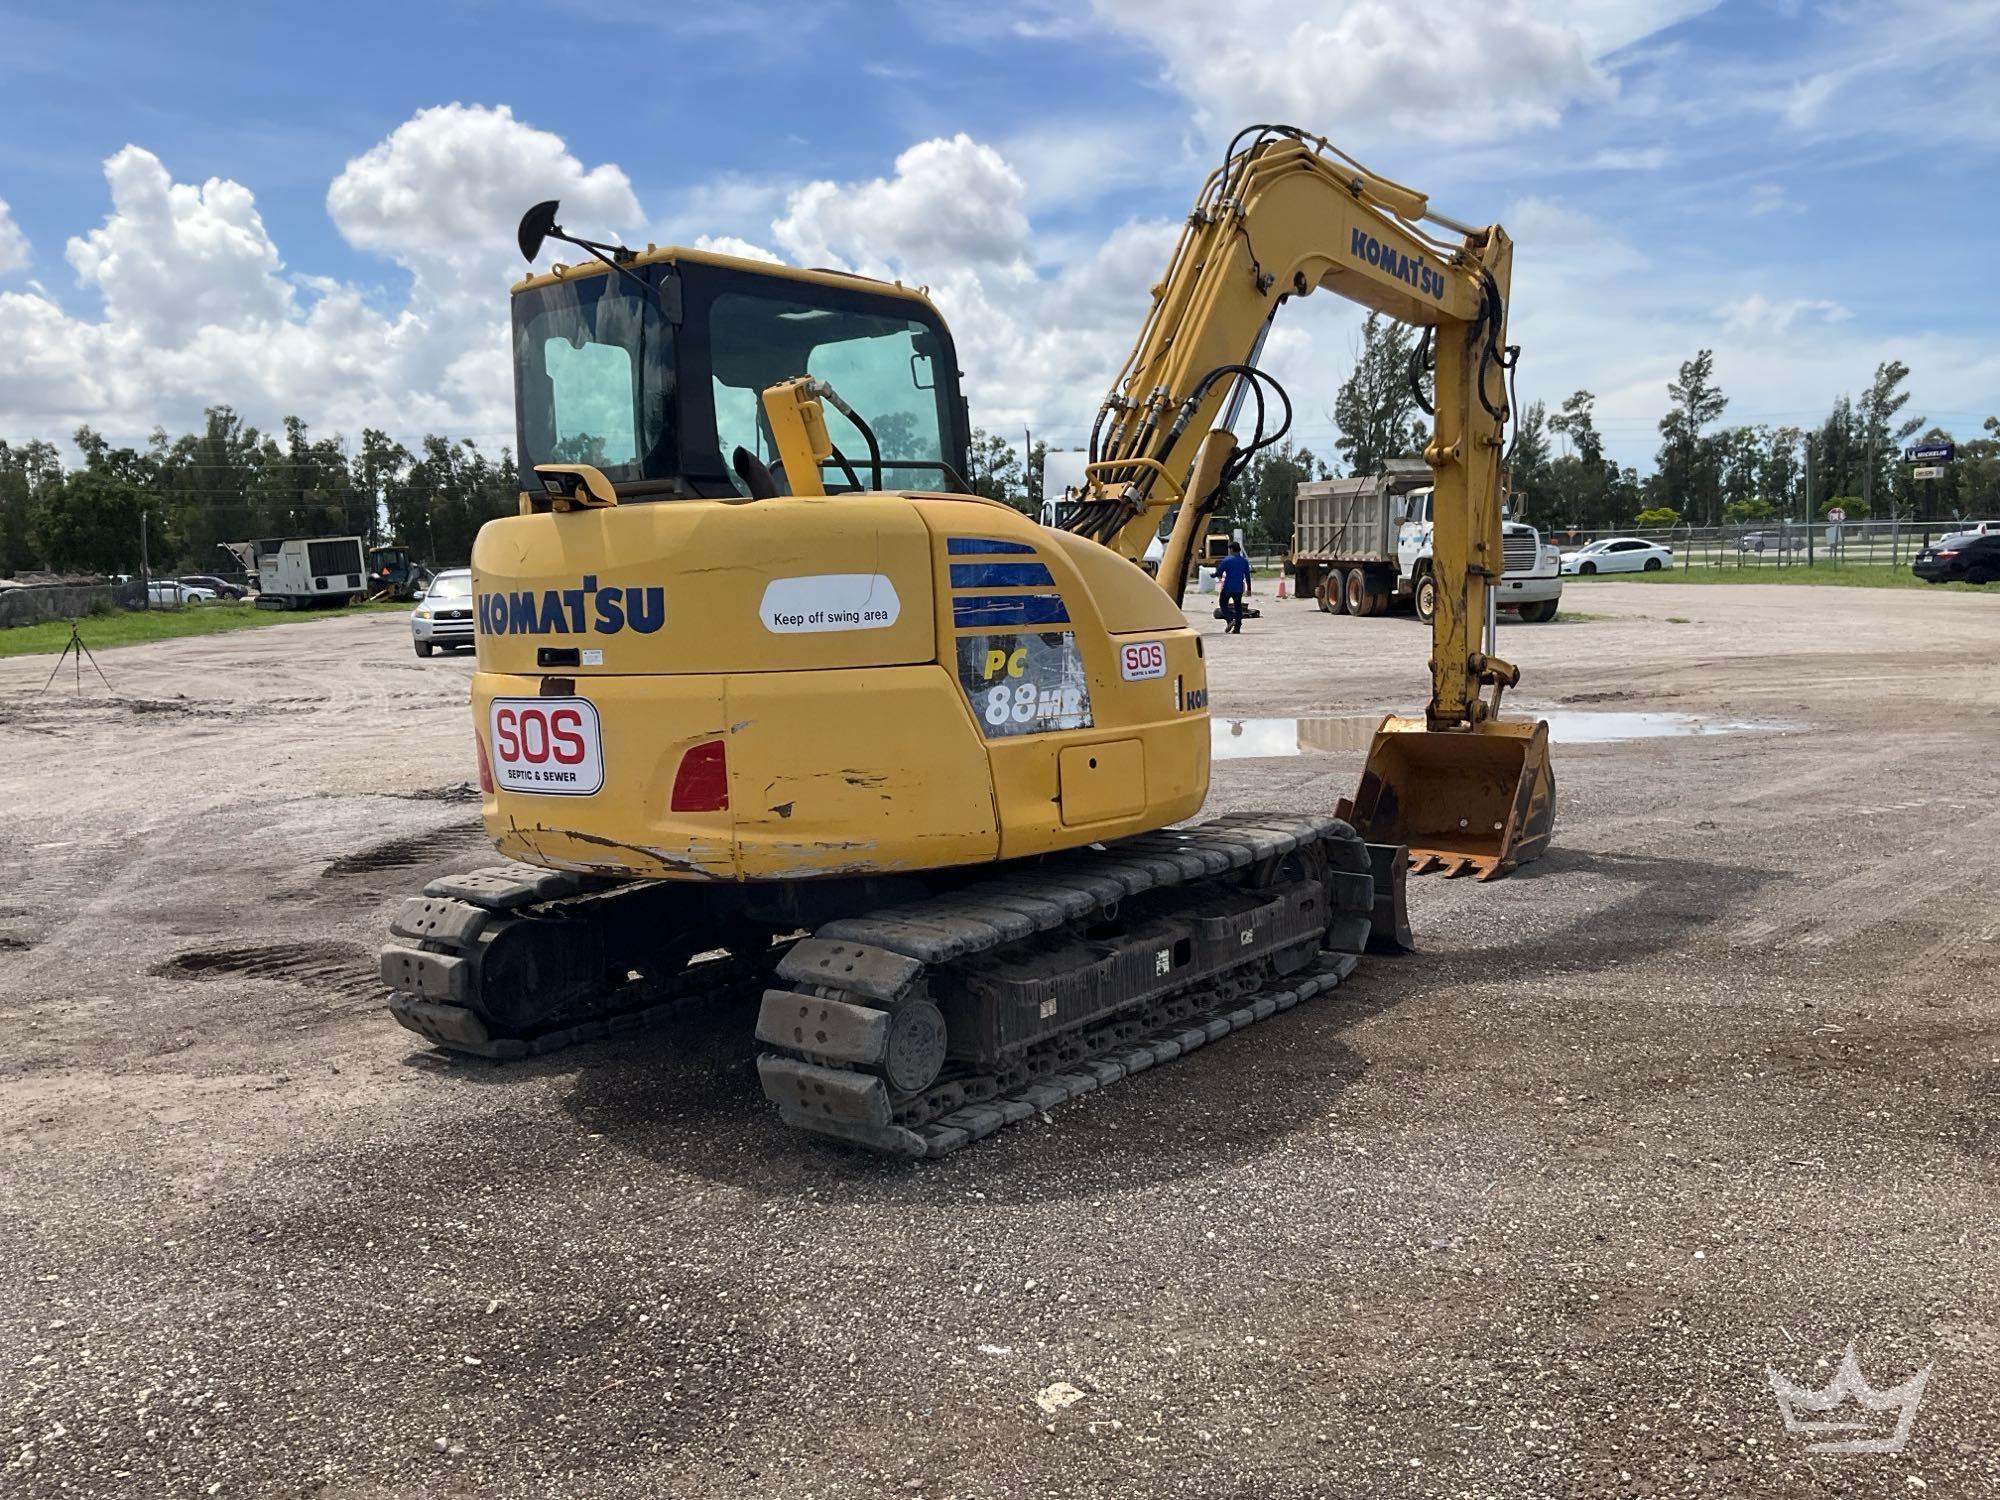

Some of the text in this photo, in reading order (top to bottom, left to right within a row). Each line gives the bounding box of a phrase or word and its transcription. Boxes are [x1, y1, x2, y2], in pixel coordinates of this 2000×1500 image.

[1351, 227, 1445, 300] KOMATSU
[478, 575, 665, 635] KOMATSU
[774, 610, 888, 626] Keep off swing area
[983, 648, 1027, 680] PC
[1126, 645, 1163, 670] SOS
[496, 708, 585, 764] SOS
[508, 769, 577, 782] SEPTIC & SEWER
